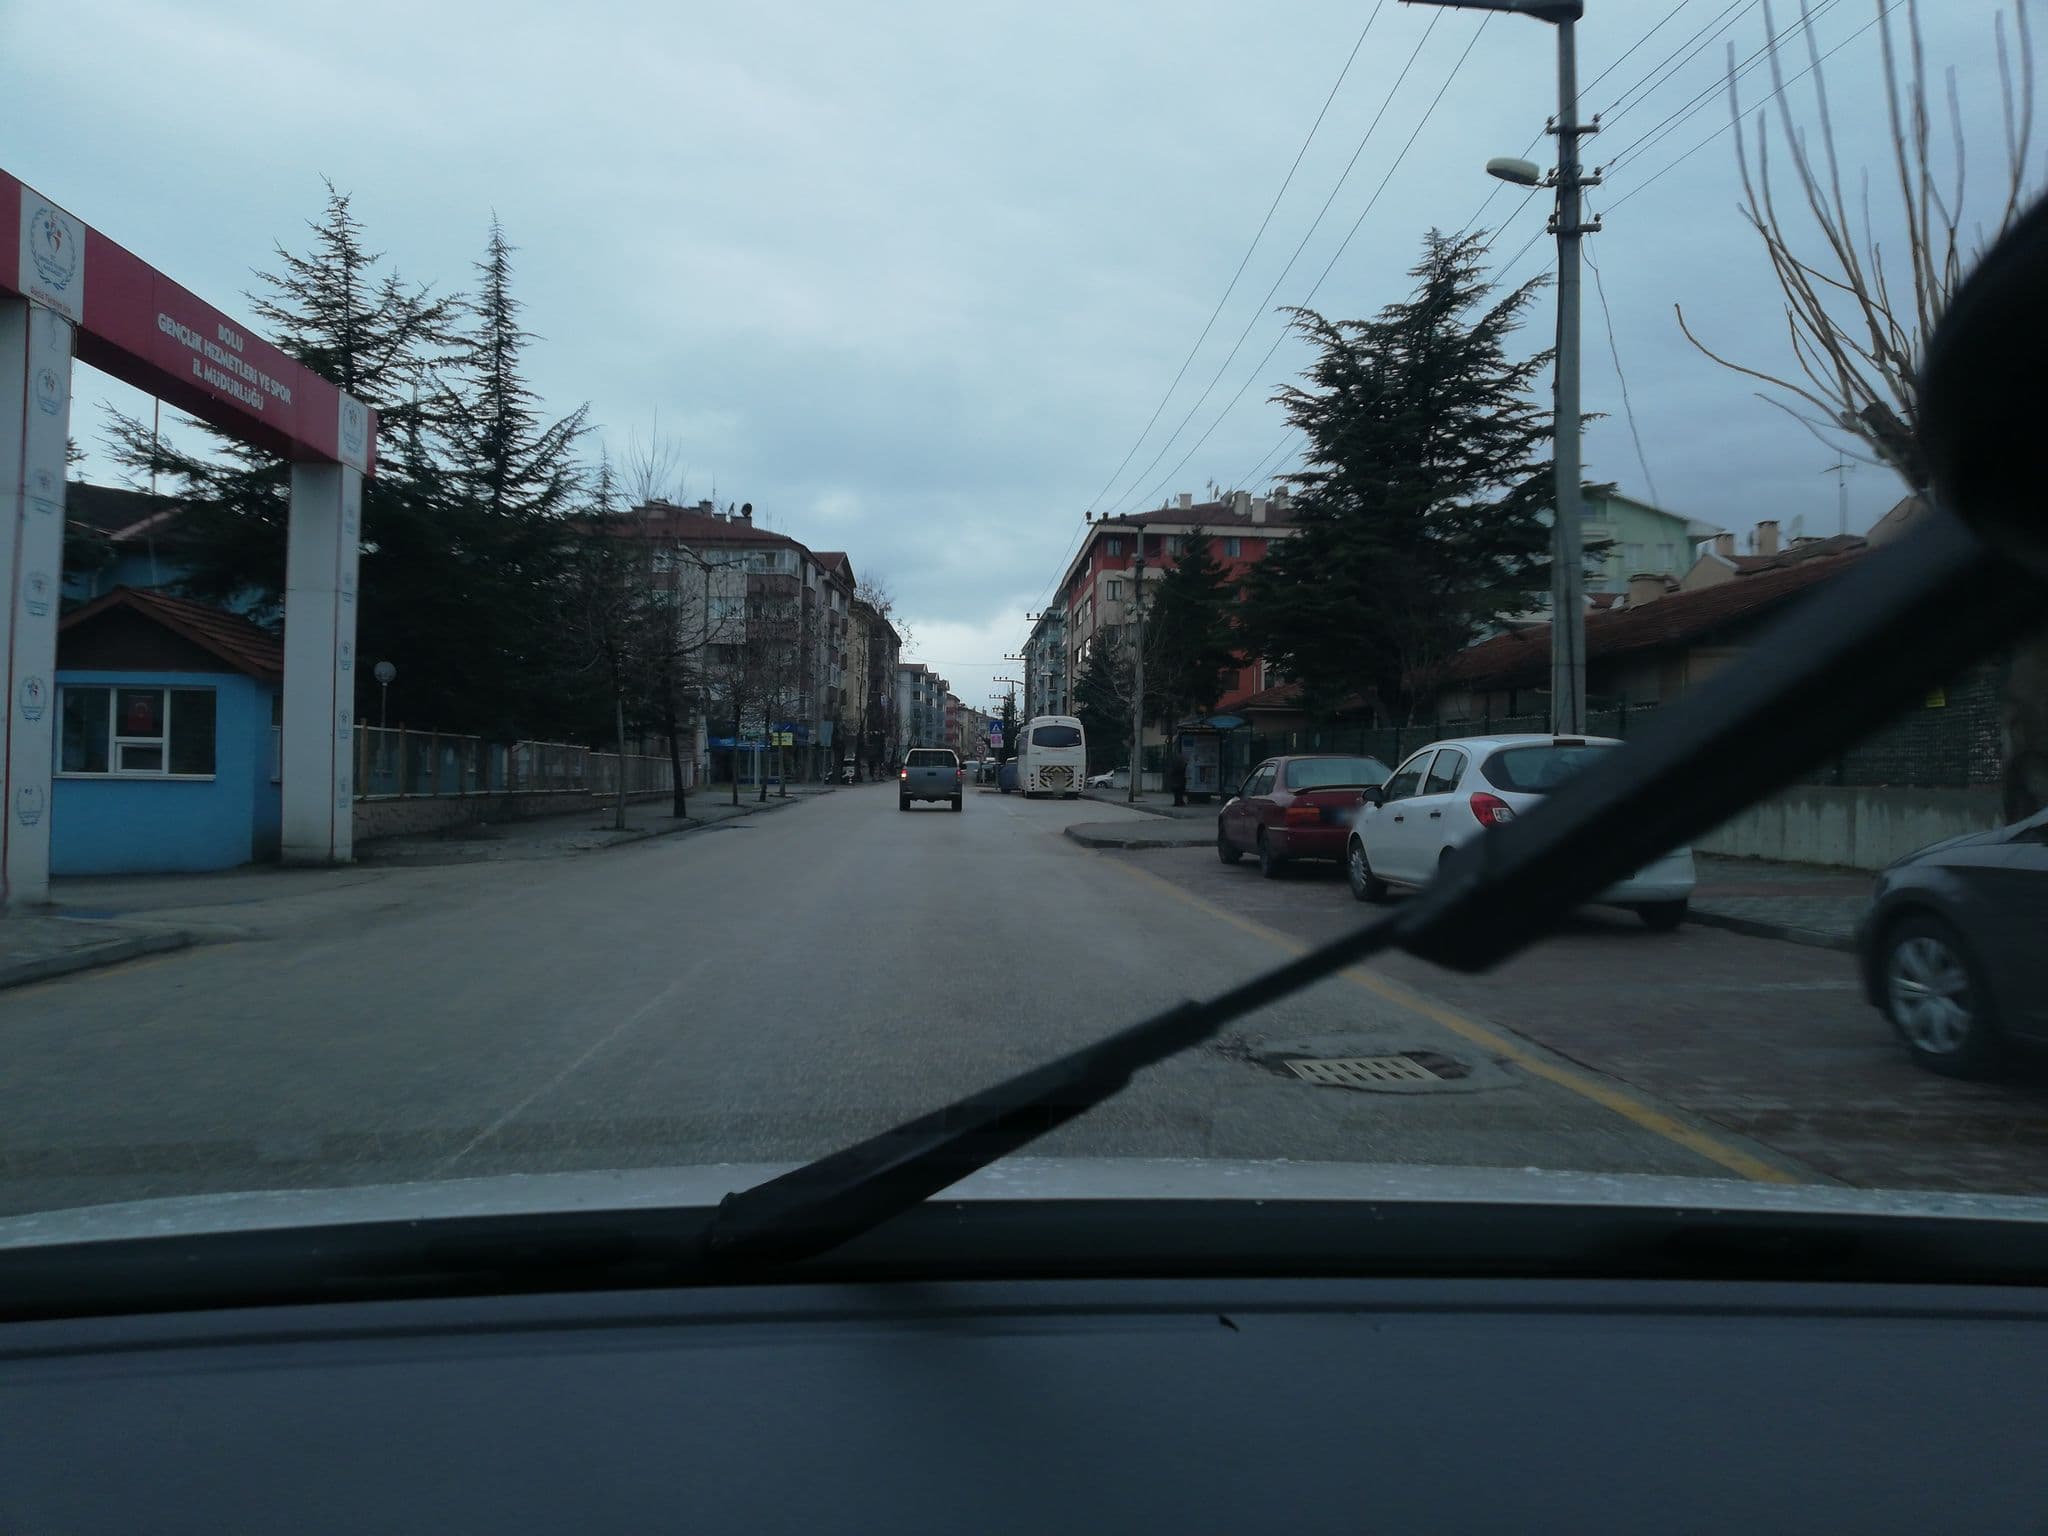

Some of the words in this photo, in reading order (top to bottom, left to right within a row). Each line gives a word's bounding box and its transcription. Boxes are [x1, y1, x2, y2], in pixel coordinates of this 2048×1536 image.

[218, 324, 243, 352] BOLU
[258, 371, 270, 392] VE
[271, 379, 291, 404] SPOR
